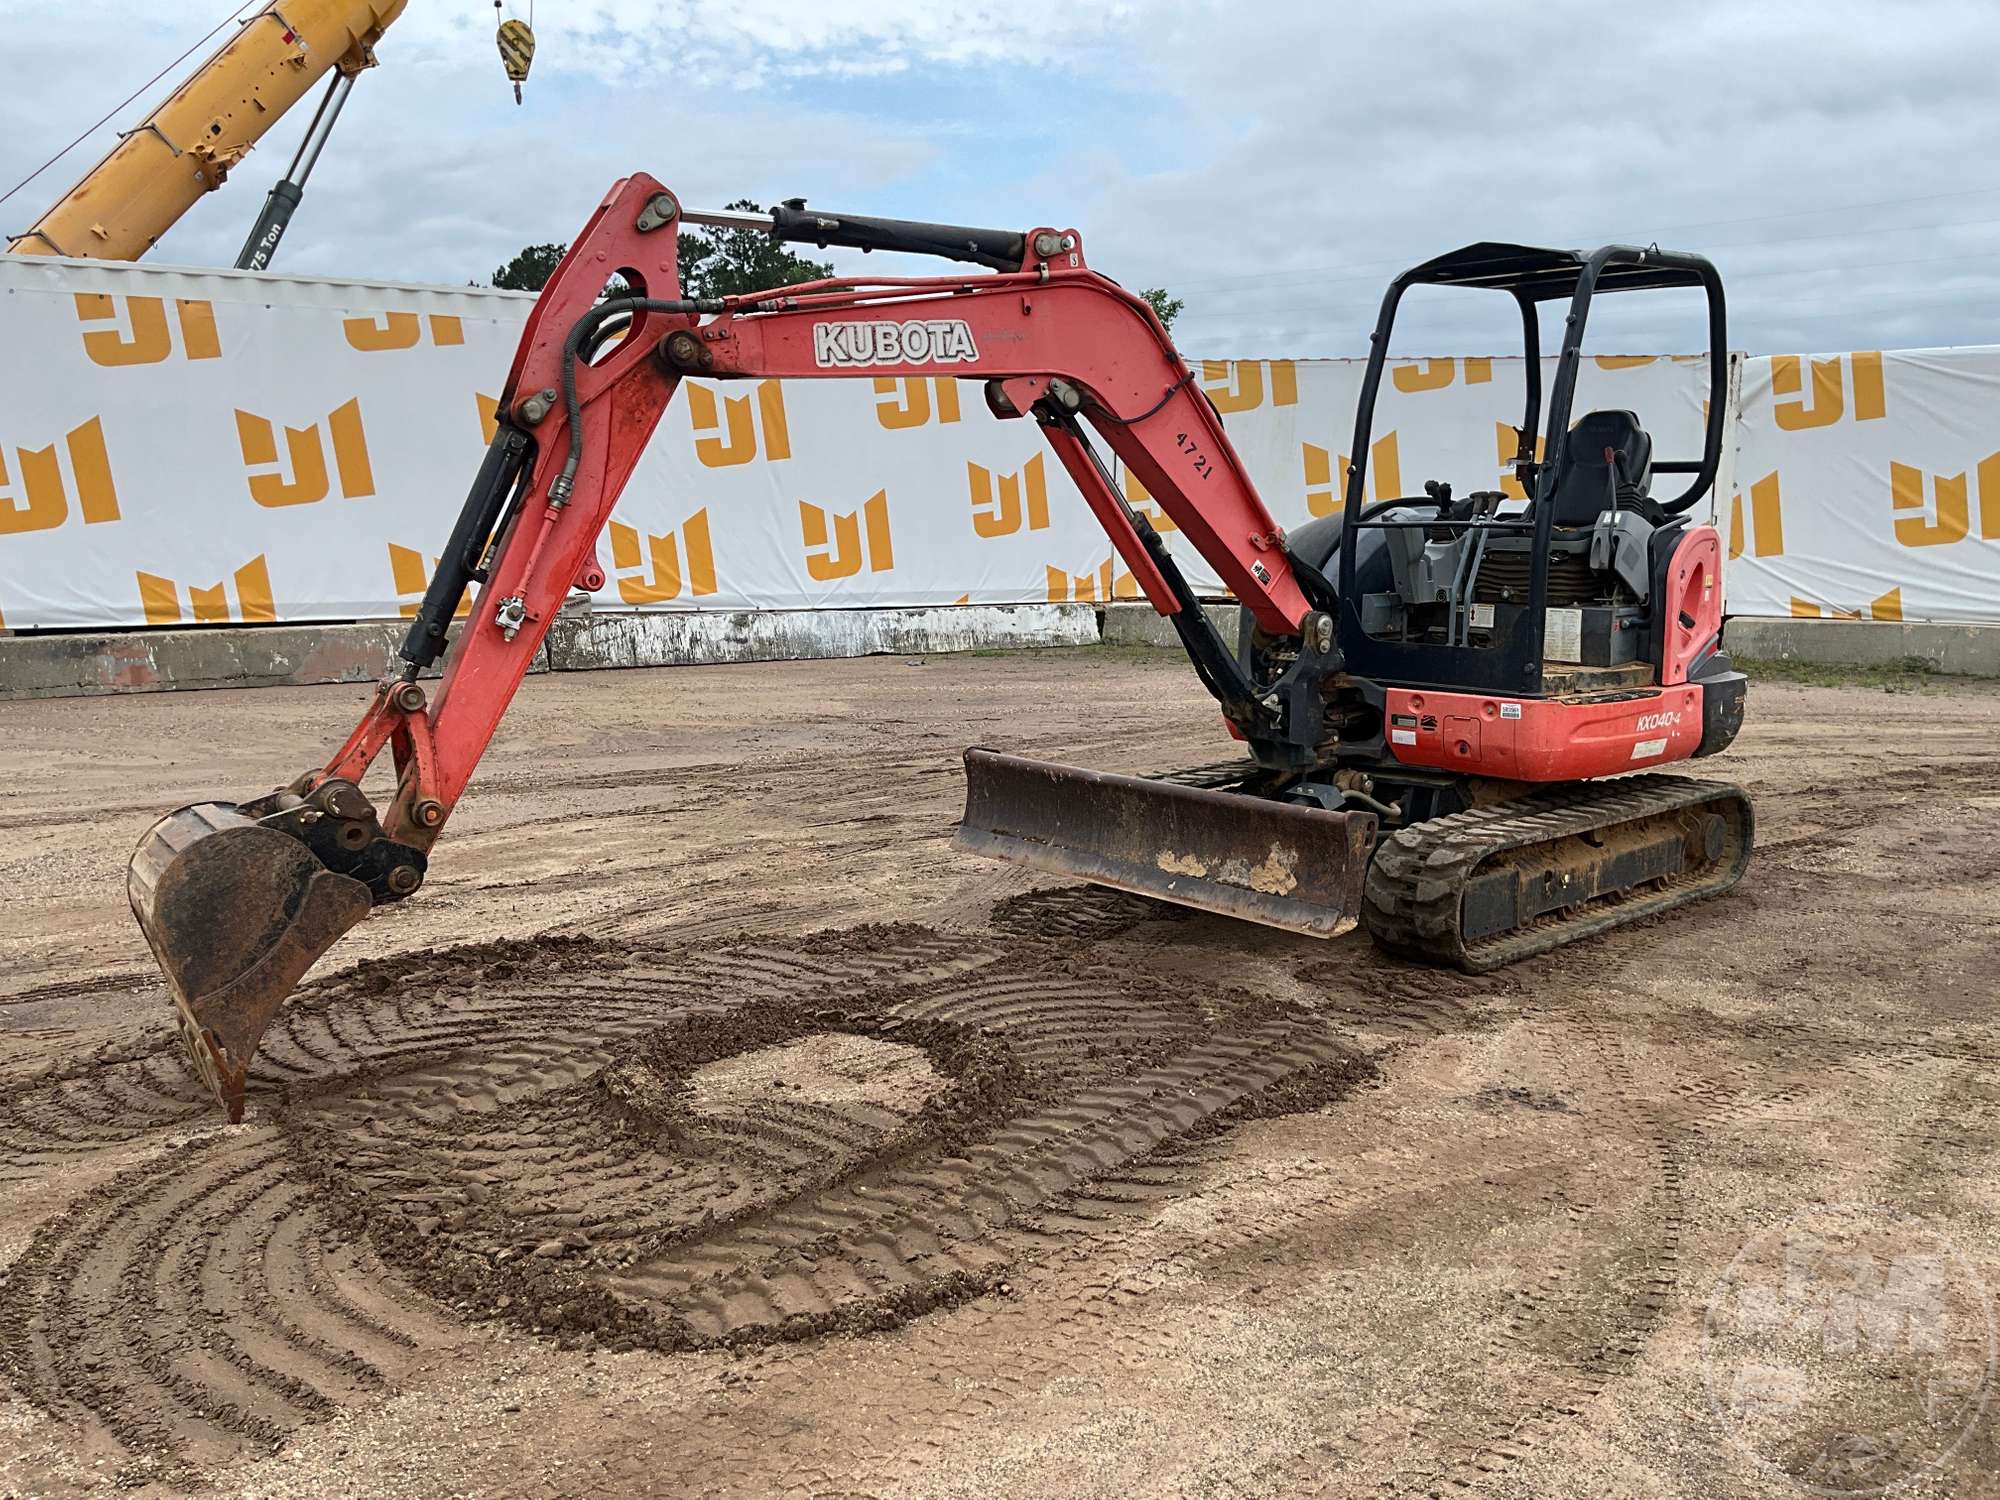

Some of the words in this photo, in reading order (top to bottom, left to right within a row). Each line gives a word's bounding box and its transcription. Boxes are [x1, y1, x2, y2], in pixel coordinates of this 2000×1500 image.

[248, 251, 267, 271] 75
[260, 223, 281, 249] Ton
[813, 320, 980, 367] KUBOTA
[1176, 433, 1213, 480] 4721
[1635, 711, 1681, 732] KX040-4
